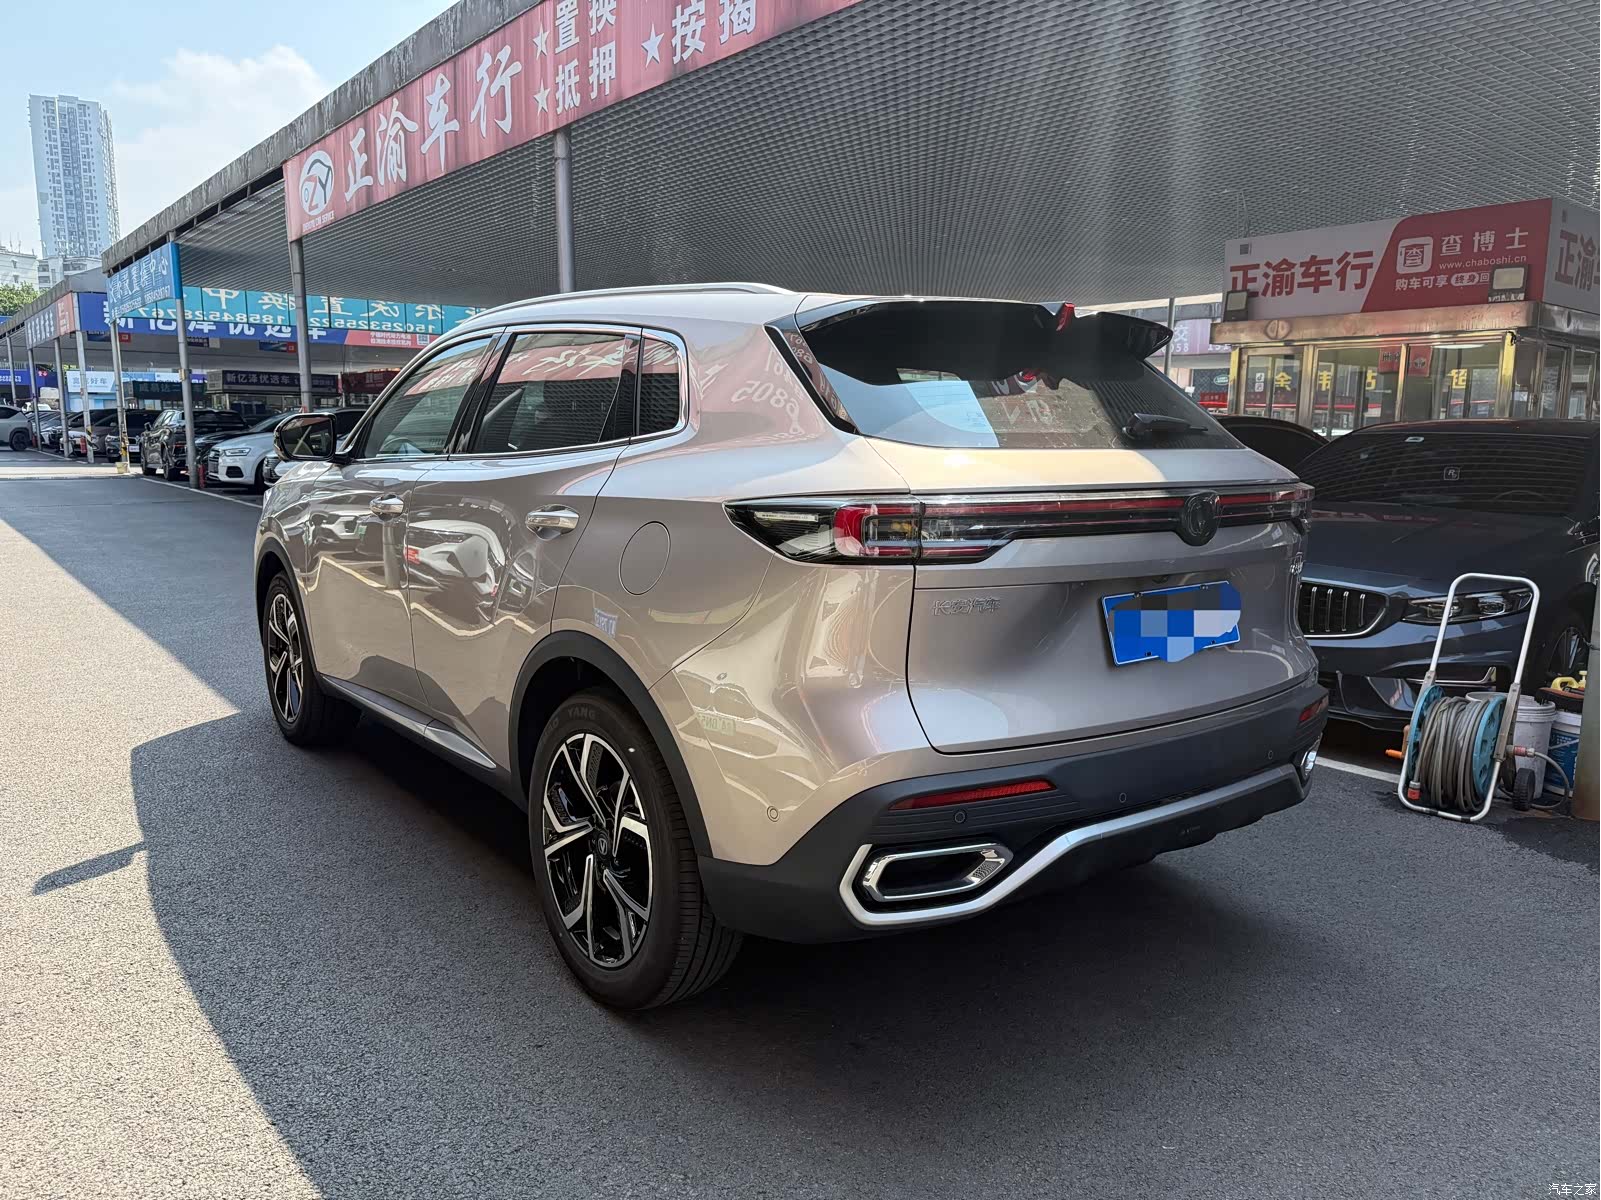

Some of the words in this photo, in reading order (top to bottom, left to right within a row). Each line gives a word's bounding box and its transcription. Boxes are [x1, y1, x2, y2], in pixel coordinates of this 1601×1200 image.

[555, 0, 617, 54] 置换
[671, 0, 757, 65] 按揭
[555, 40, 617, 115] 抵押
[344, 44, 522, 202] 正渝车行
[1439, 254, 1527, 270] www.chaboshi.cn
[1440, 227, 1529, 256] 查博士
[1554, 229, 1601, 292] 正渝
[1229, 250, 1374, 298] 正渝车行
[933, 595, 1000, 616] 长安汽车
[567, 706, 597, 721] YANG
